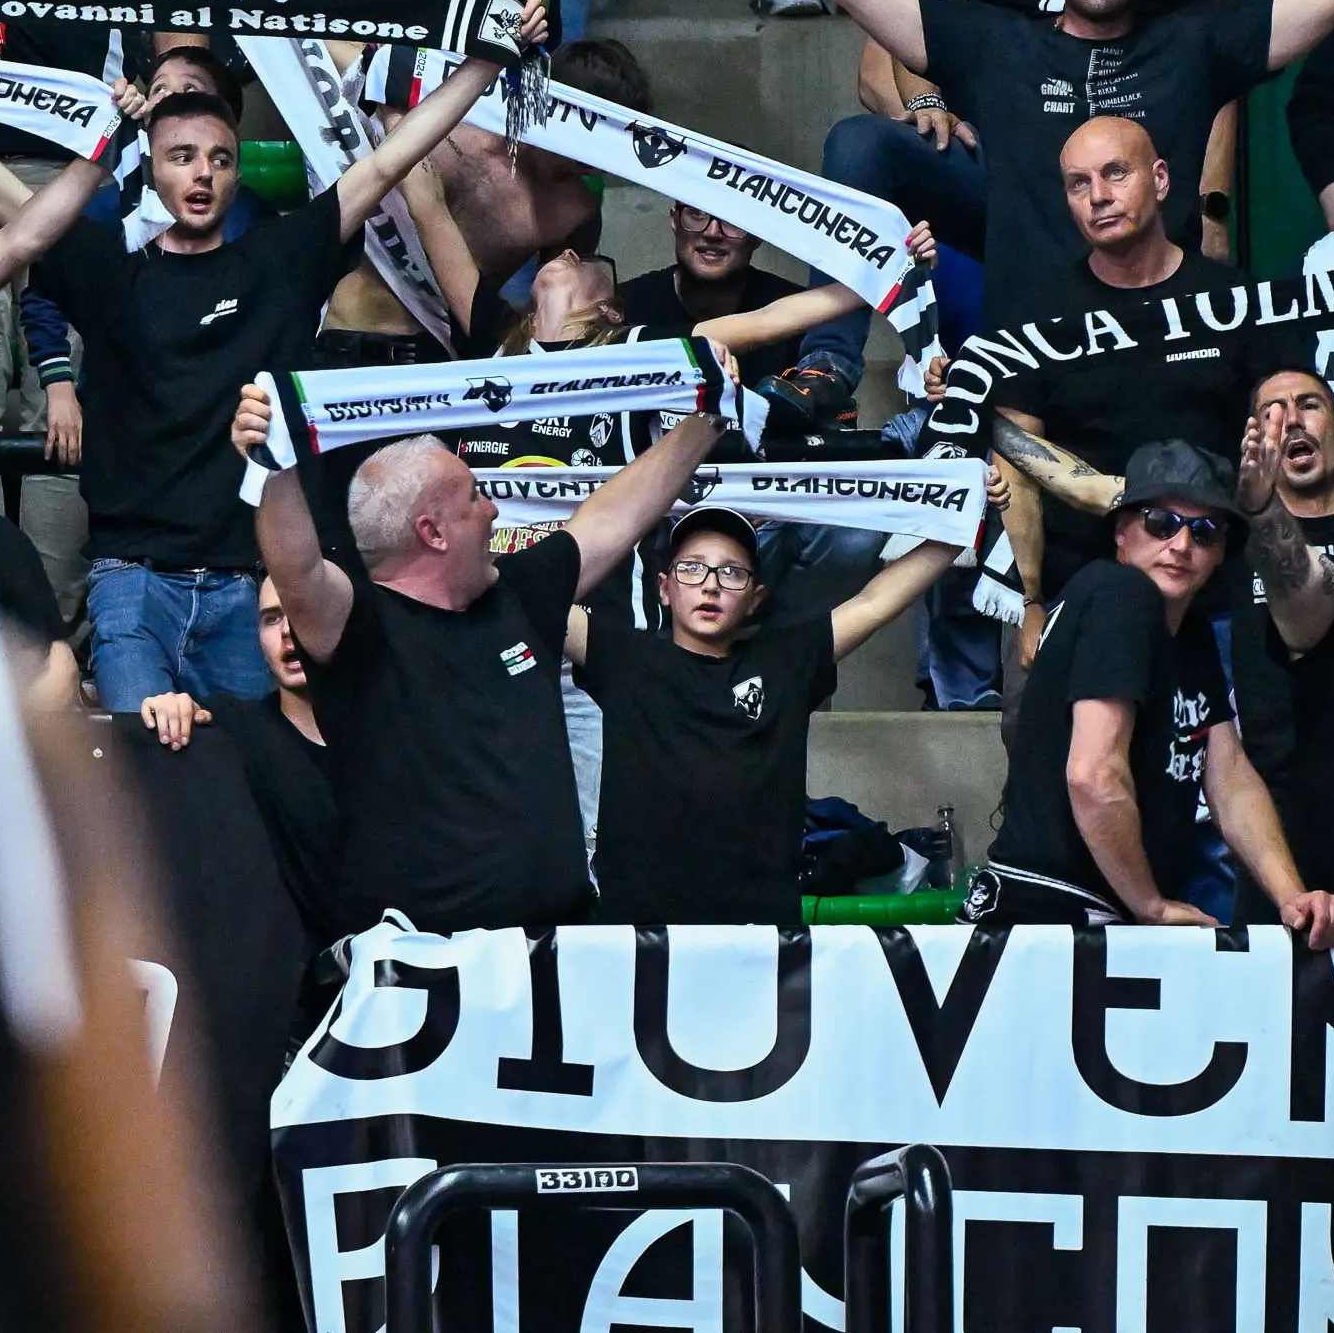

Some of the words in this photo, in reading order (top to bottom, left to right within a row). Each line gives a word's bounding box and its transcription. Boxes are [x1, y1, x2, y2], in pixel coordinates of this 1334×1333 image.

[169, 5, 215, 29] al
[227, 5, 429, 42] Natisone
[1043, 100, 1076, 114] CHART
[416, 53, 427, 78] 2024
[707, 156, 897, 270] BIANCONERA
[932, 309, 1139, 435] CONCA
[531, 423, 573, 439] ENERGY
[462, 440, 510, 456] SYNERGIE
